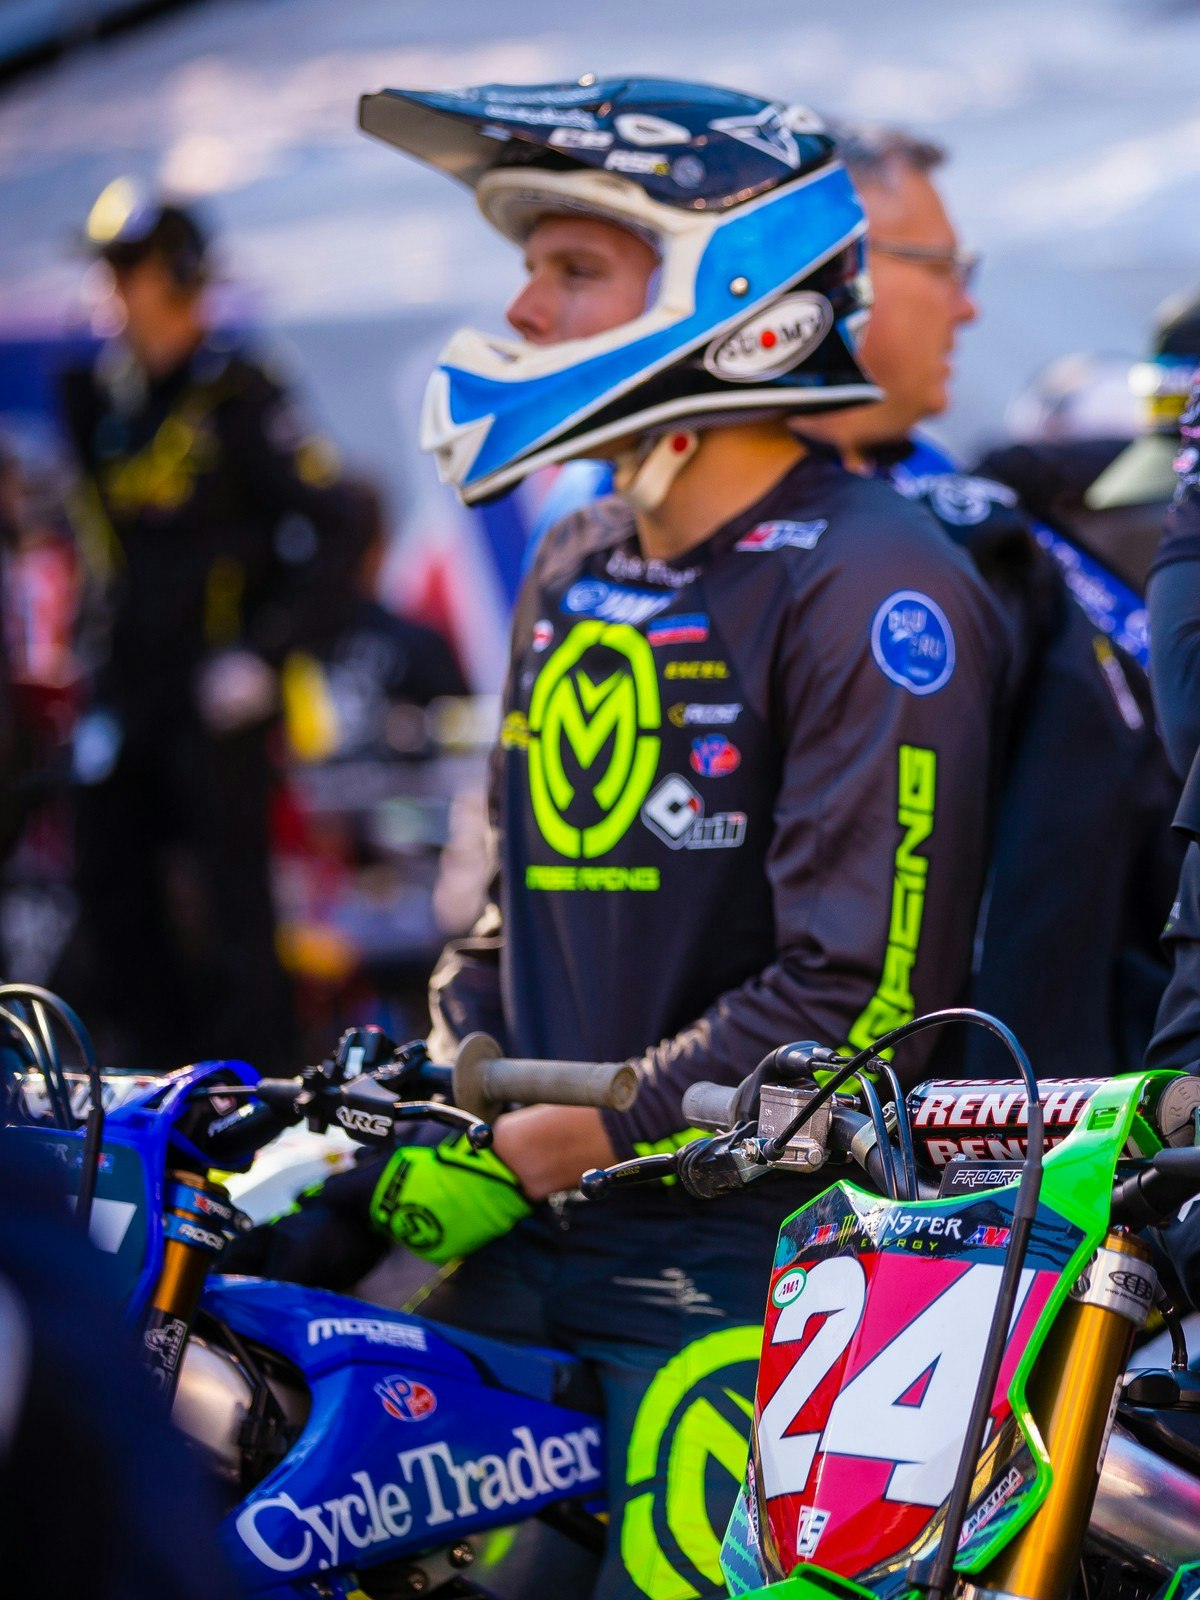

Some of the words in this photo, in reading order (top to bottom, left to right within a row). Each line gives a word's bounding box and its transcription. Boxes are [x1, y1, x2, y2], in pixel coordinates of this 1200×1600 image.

[337, 1105, 393, 1137] ARC
[861, 1237, 939, 1251] ENERGY
[778, 1279, 800, 1298] AMA
[757, 1255, 1037, 1507] 24
